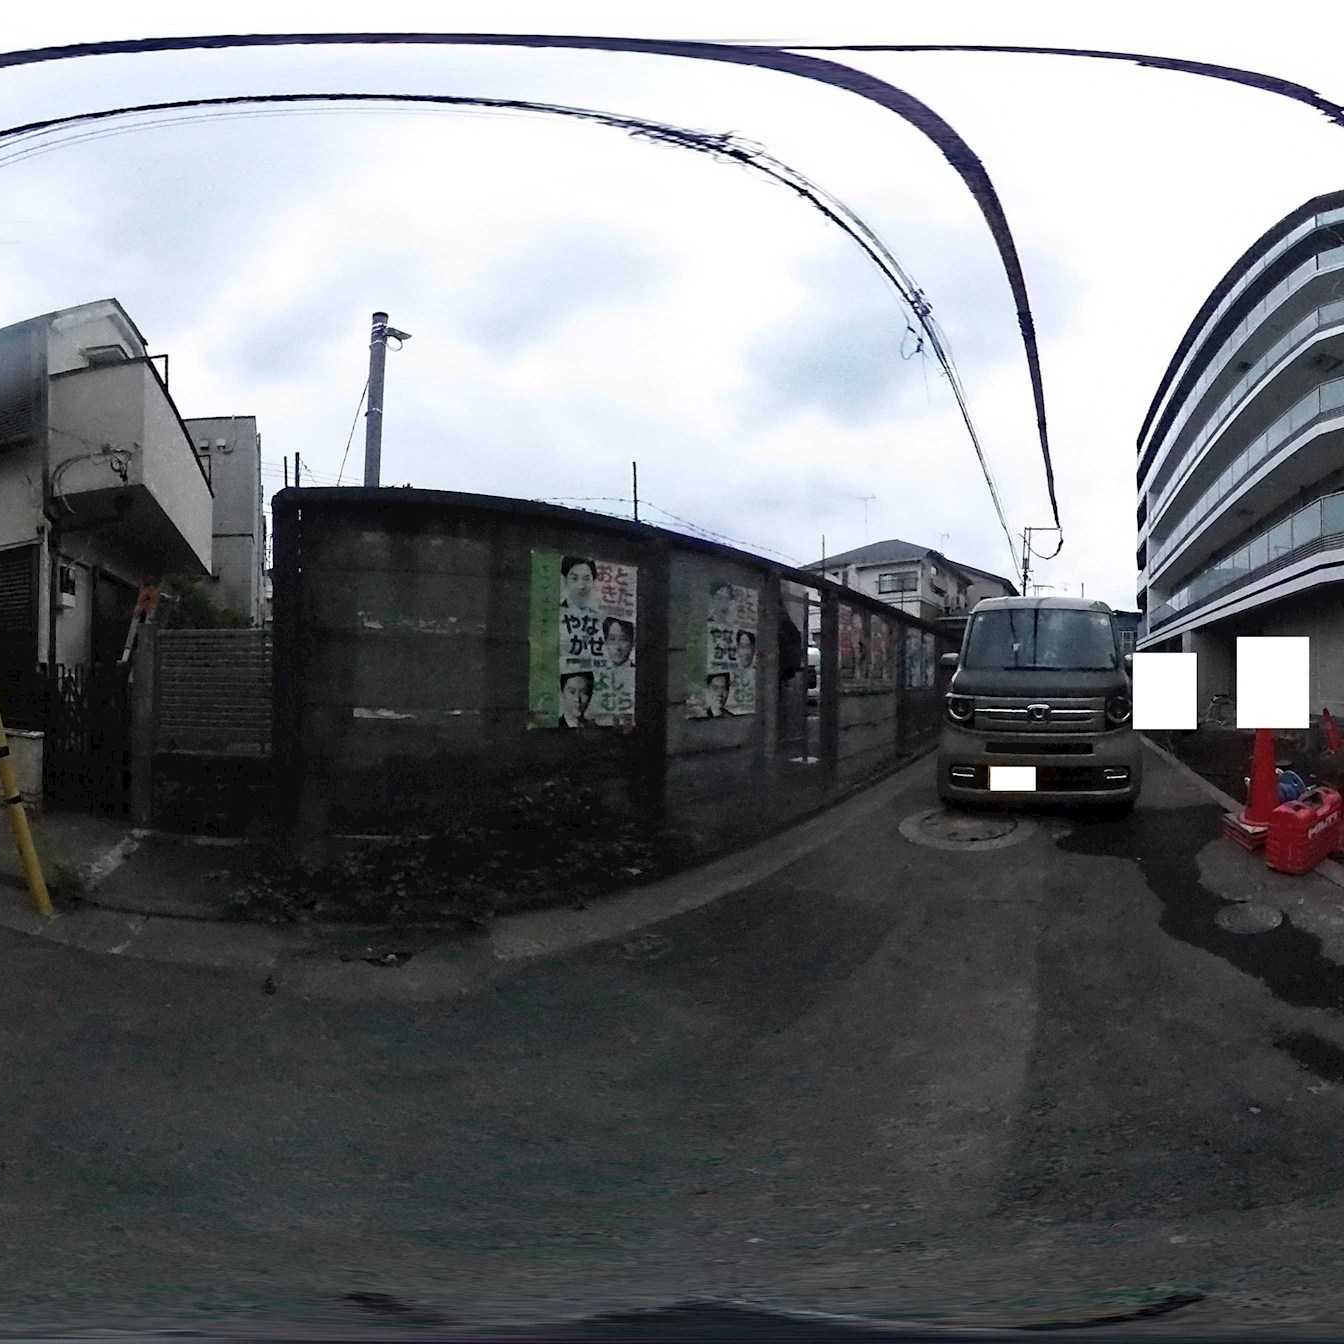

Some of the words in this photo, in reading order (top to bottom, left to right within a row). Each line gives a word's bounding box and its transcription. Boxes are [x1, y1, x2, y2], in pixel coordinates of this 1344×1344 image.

[597, 564, 630, 586] おと
[602, 587, 635, 606] きた
[562, 613, 598, 635] やな
[569, 635, 605, 657] がせ
[593, 673, 625, 692] よし
[601, 692, 633, 711] むら
